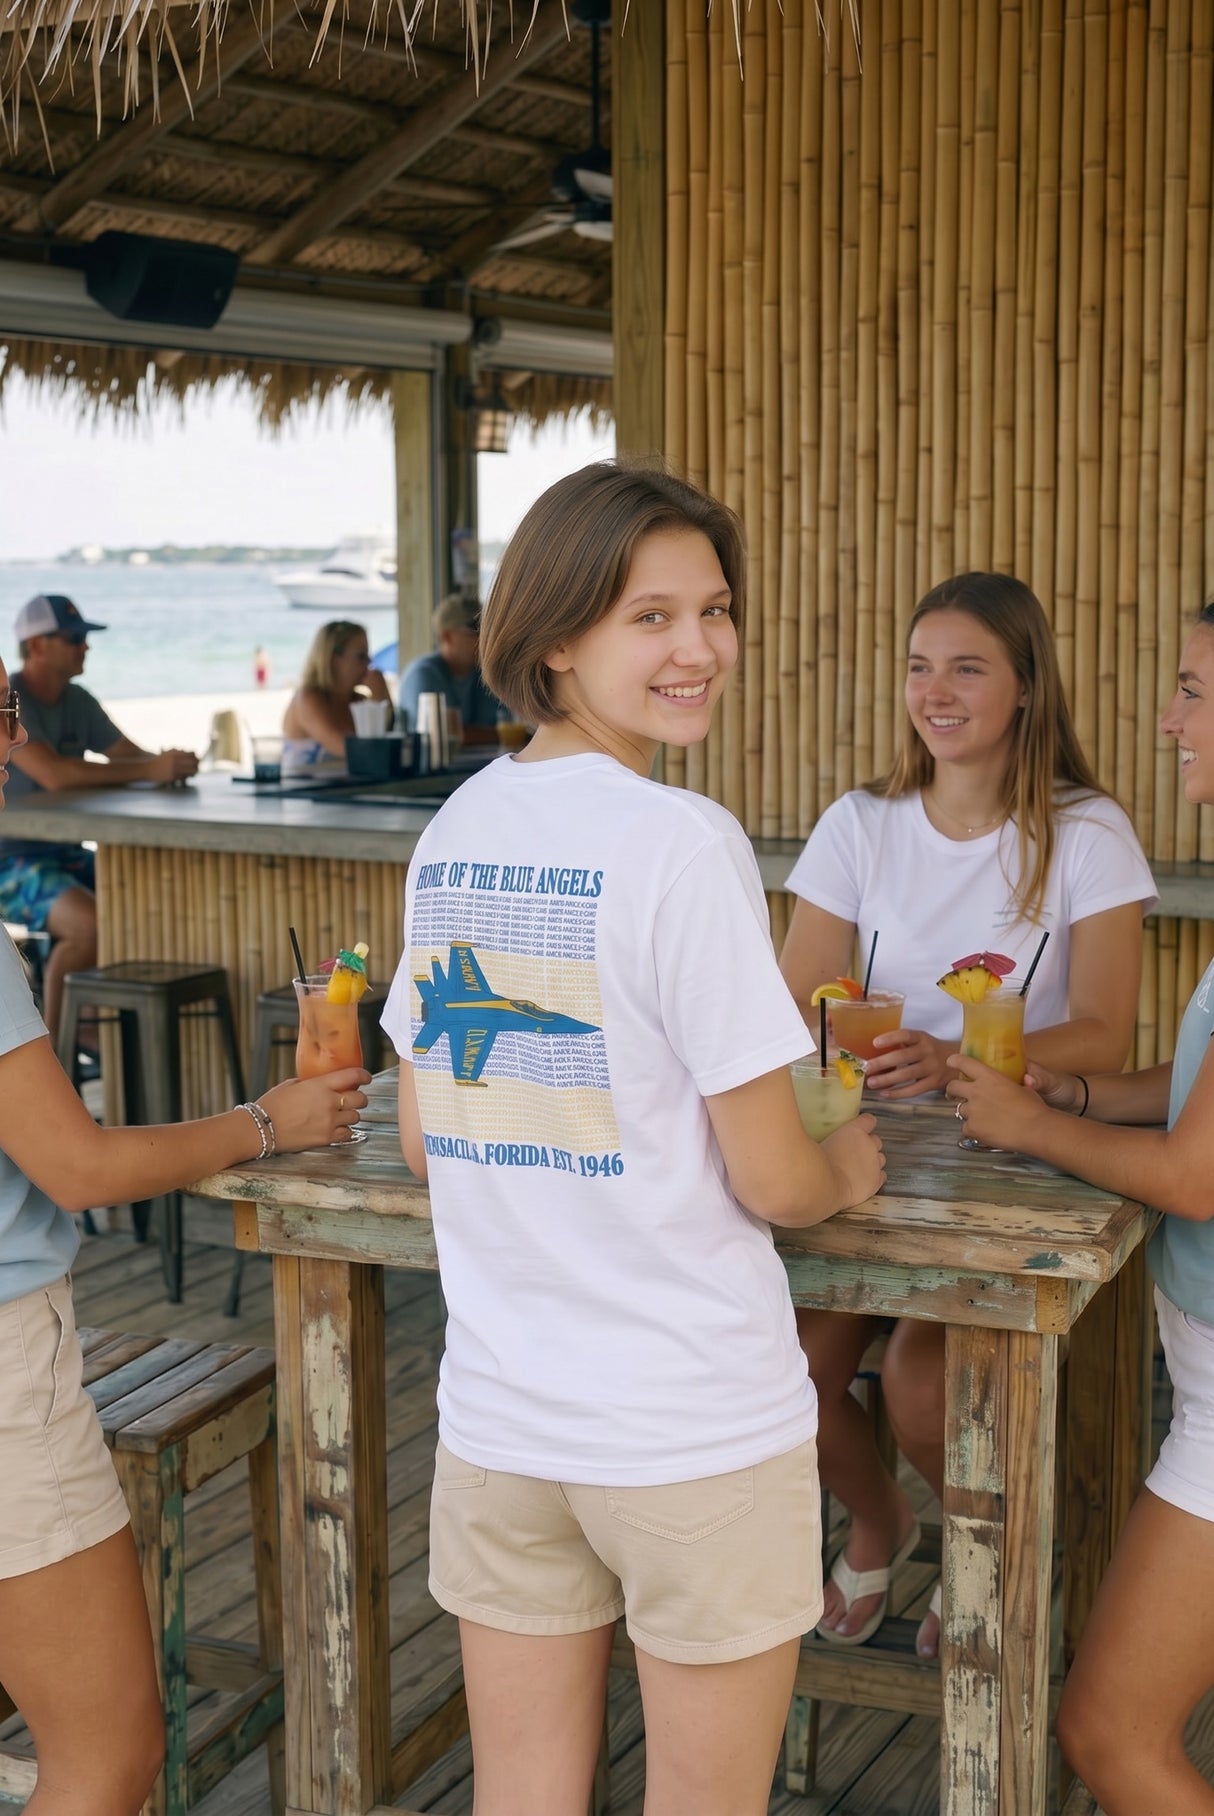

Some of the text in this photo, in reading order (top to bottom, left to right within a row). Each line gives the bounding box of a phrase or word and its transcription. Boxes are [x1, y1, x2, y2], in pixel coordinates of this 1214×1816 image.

[416, 862, 604, 898] HOME OF THE BLUE ANGELS
[551, 1147, 577, 1174] EST.
[578, 1152, 625, 1178] 1946
